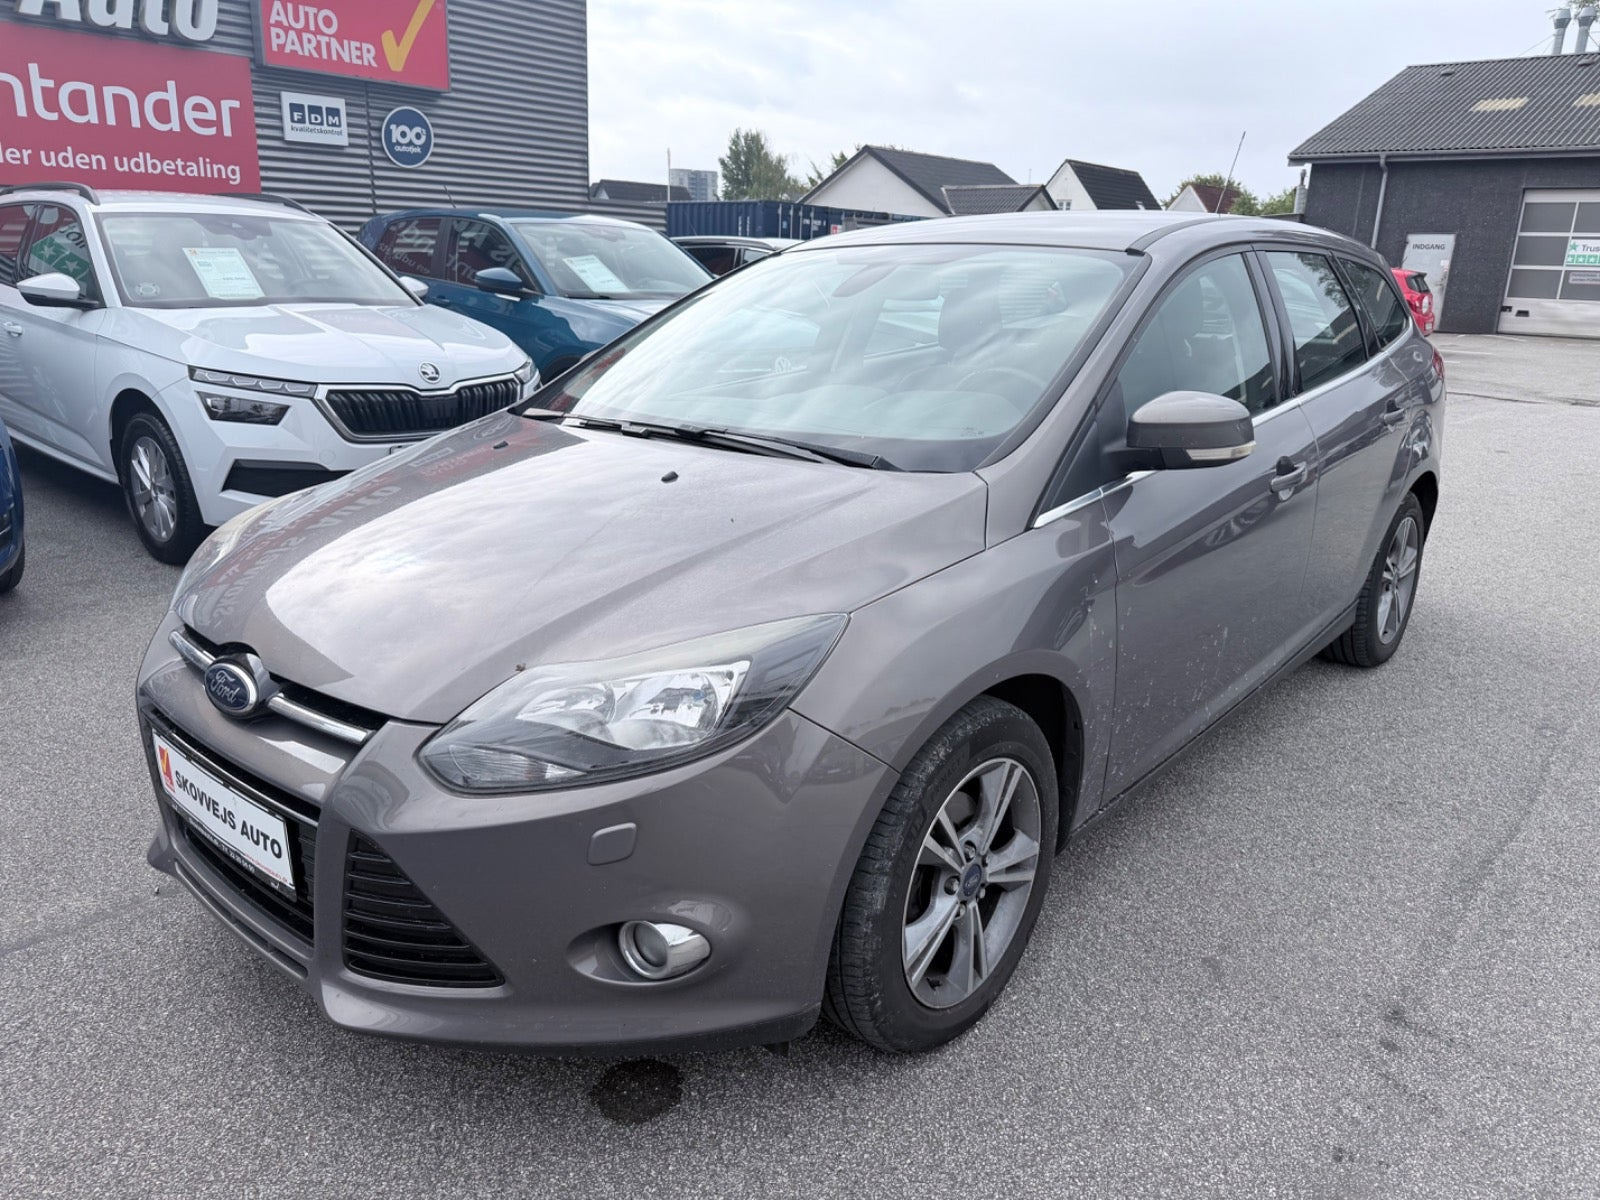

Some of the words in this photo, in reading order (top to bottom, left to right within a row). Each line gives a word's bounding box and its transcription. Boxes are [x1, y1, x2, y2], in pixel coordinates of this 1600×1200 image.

[269, 0, 338, 35] AUTO
[270, 27, 378, 67] PARTNER
[291, 109, 340, 126] FDM
[291, 125, 343, 136] kvalitetskontrol
[40, 146, 107, 170] uden
[114, 152, 241, 185] udbetaling
[394, 145, 422, 154] autotjek
[210, 668, 241, 704] Ford
[175, 770, 237, 830] SKOVVEJS
[241, 820, 283, 859] AUTO
